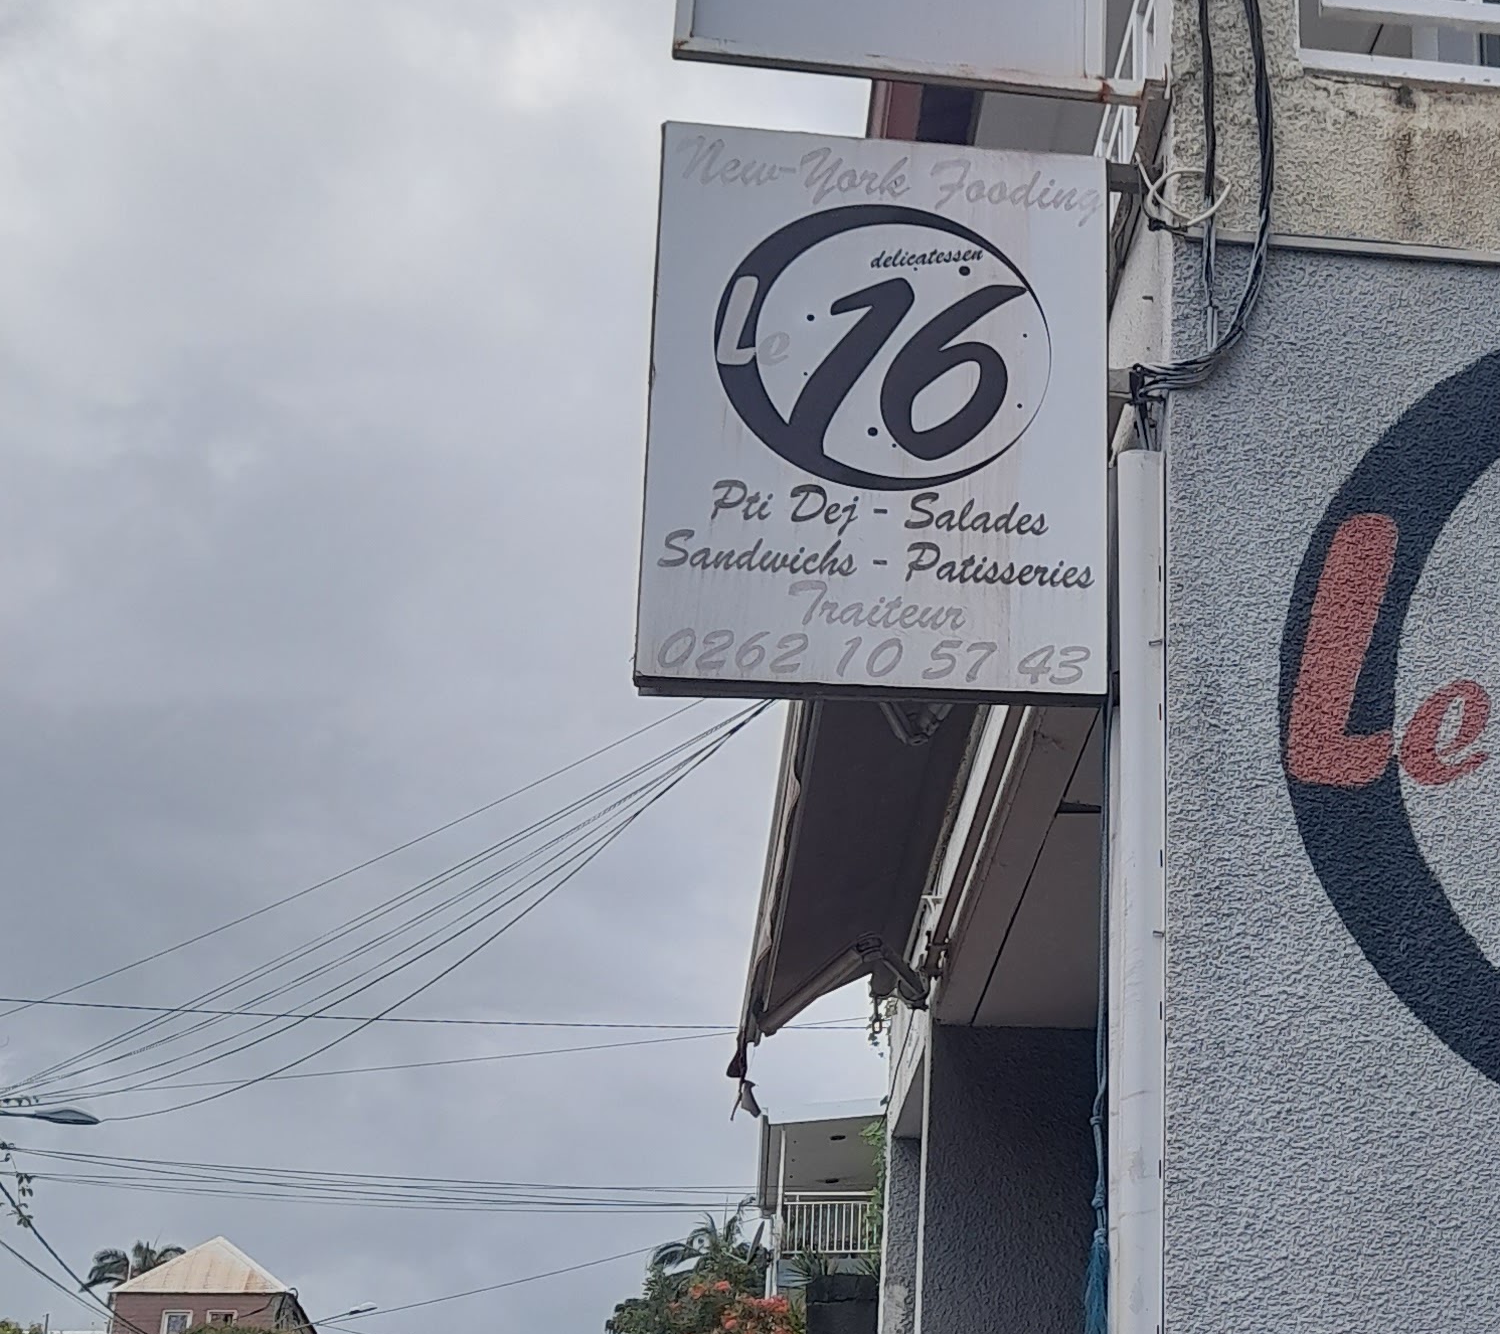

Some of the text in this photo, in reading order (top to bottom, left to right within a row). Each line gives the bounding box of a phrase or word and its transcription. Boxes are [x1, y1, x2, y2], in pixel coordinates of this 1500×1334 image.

[930, 159, 1104, 227] Fooding
[870, 248, 984, 269] delicatessen
[716, 275, 1028, 461] Le 16
[711, 479, 773, 520] Pti
[790, 483, 859, 536] Dej
[904, 491, 1049, 536] Salades
[656, 528, 858, 576] Sandwichs
[905, 541, 1095, 589] Patisseries
[788, 579, 967, 631] Traiteur
[657, 627, 1091, 685] 0262 10 57 43
[1286, 512, 1491, 787] Le
